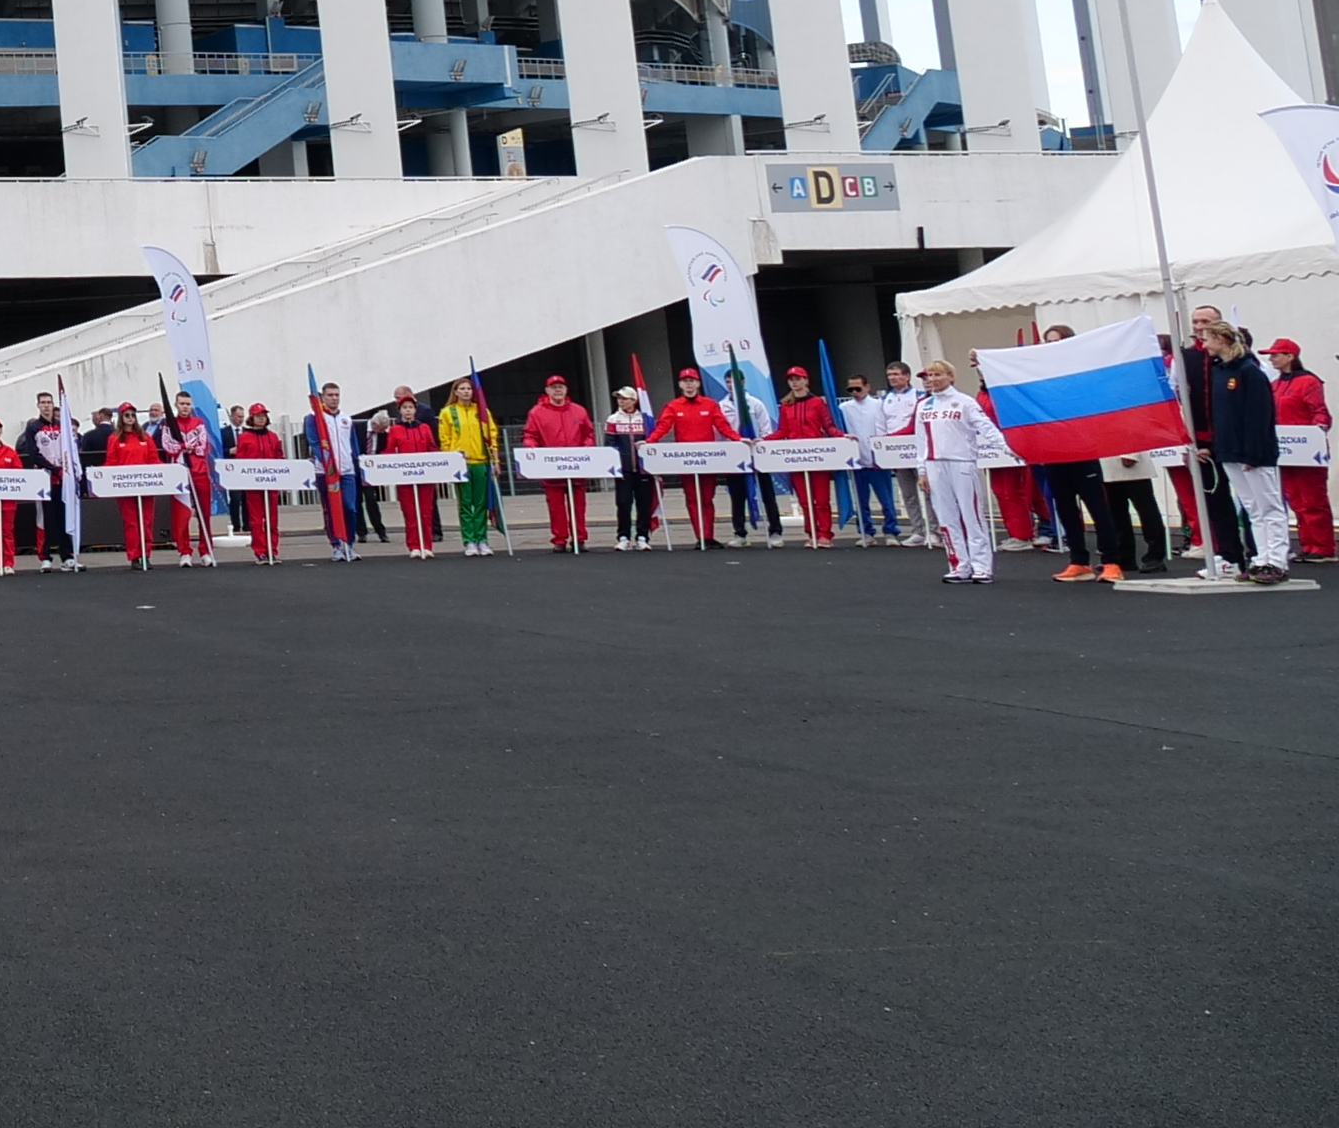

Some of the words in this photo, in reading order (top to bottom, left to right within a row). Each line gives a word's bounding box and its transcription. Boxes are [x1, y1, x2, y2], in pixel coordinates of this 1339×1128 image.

[792, 178, 806, 197] A
[812, 171, 835, 204] D
[845, 178, 857, 196] C
[864, 178, 876, 196] B
[662, 449, 727, 458] ХАБАРОВСКИЙ
[770, 446, 836, 455] АСТРАХАНСКАЯ
[544, 455, 590, 463] ПЕРМСКИЙ
[683, 457, 707, 466] КРАЙ
[784, 455, 824, 463] ОБЛАСТЬ
[376, 459, 449, 469] КРАСНОДАРСКИЙ
[556, 462, 580, 471] КРАЙ
[240, 466, 290, 475] АЛТАЙСКИЙ
[402, 468, 425, 476] КРАЙ
[112, 480, 164, 488] РЕСПУБЛИКА
